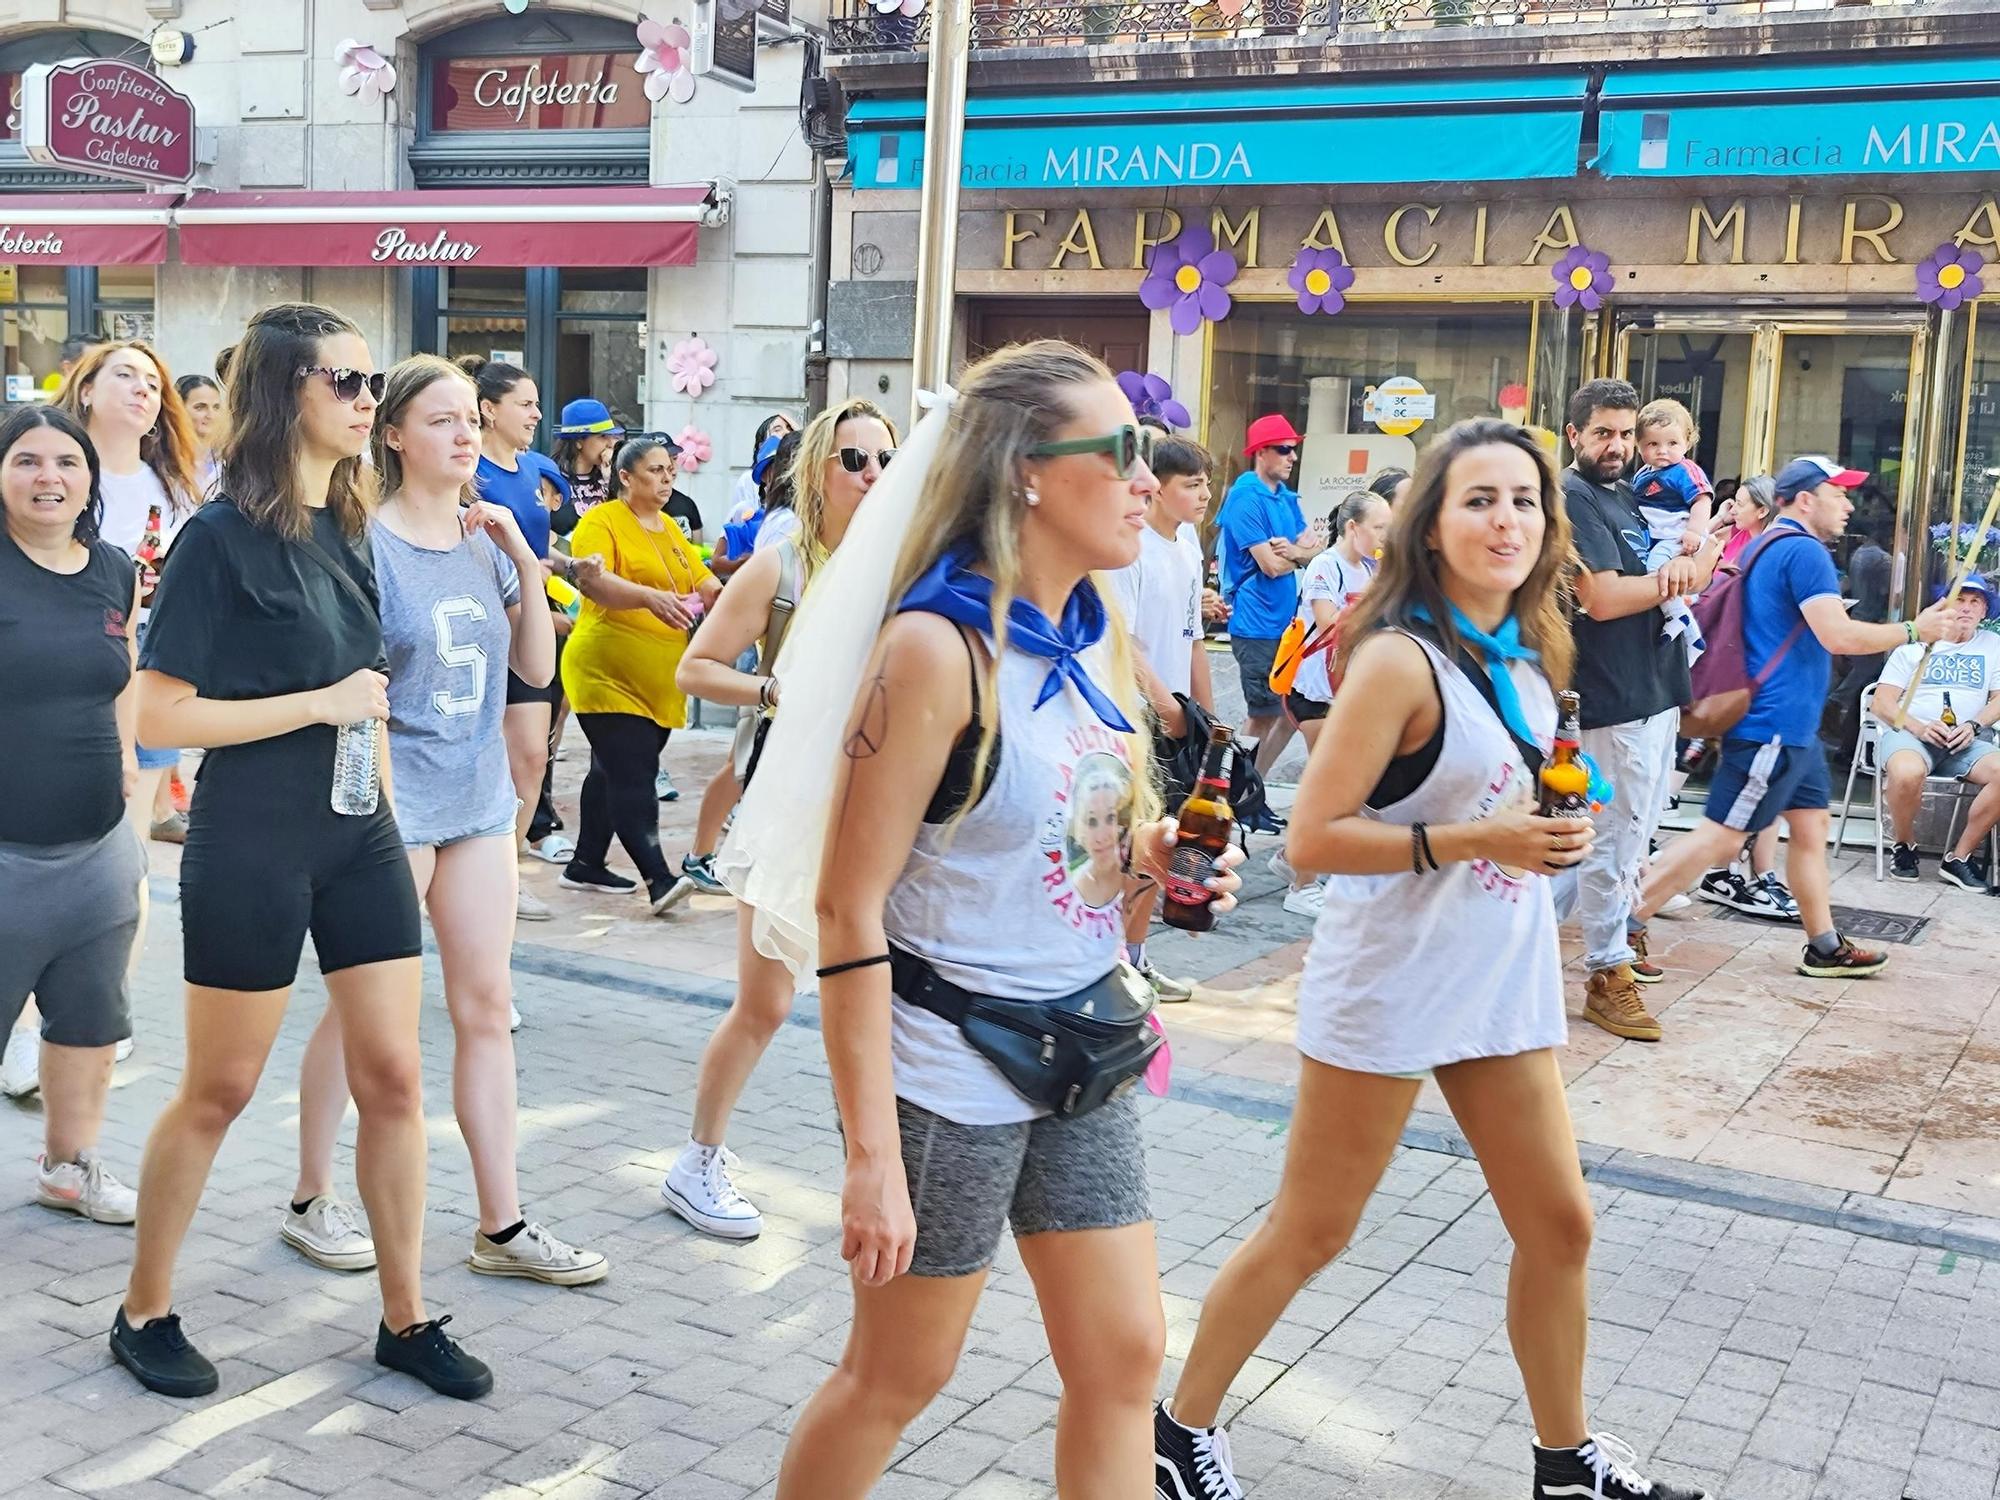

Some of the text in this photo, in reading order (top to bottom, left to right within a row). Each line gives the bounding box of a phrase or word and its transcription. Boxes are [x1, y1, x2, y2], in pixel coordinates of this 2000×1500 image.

[80, 68, 167, 106] Confitería
[474, 64, 619, 122] Cafetería
[61, 92, 181, 148] Pastur
[85, 138, 161, 172] Cafetería
[910, 142, 1253, 183] Fmacia MIRANDA
[1685, 136, 1843, 167] Farmacia
[371, 227, 482, 262] Pastur
[1319, 477, 1331, 485] LA
